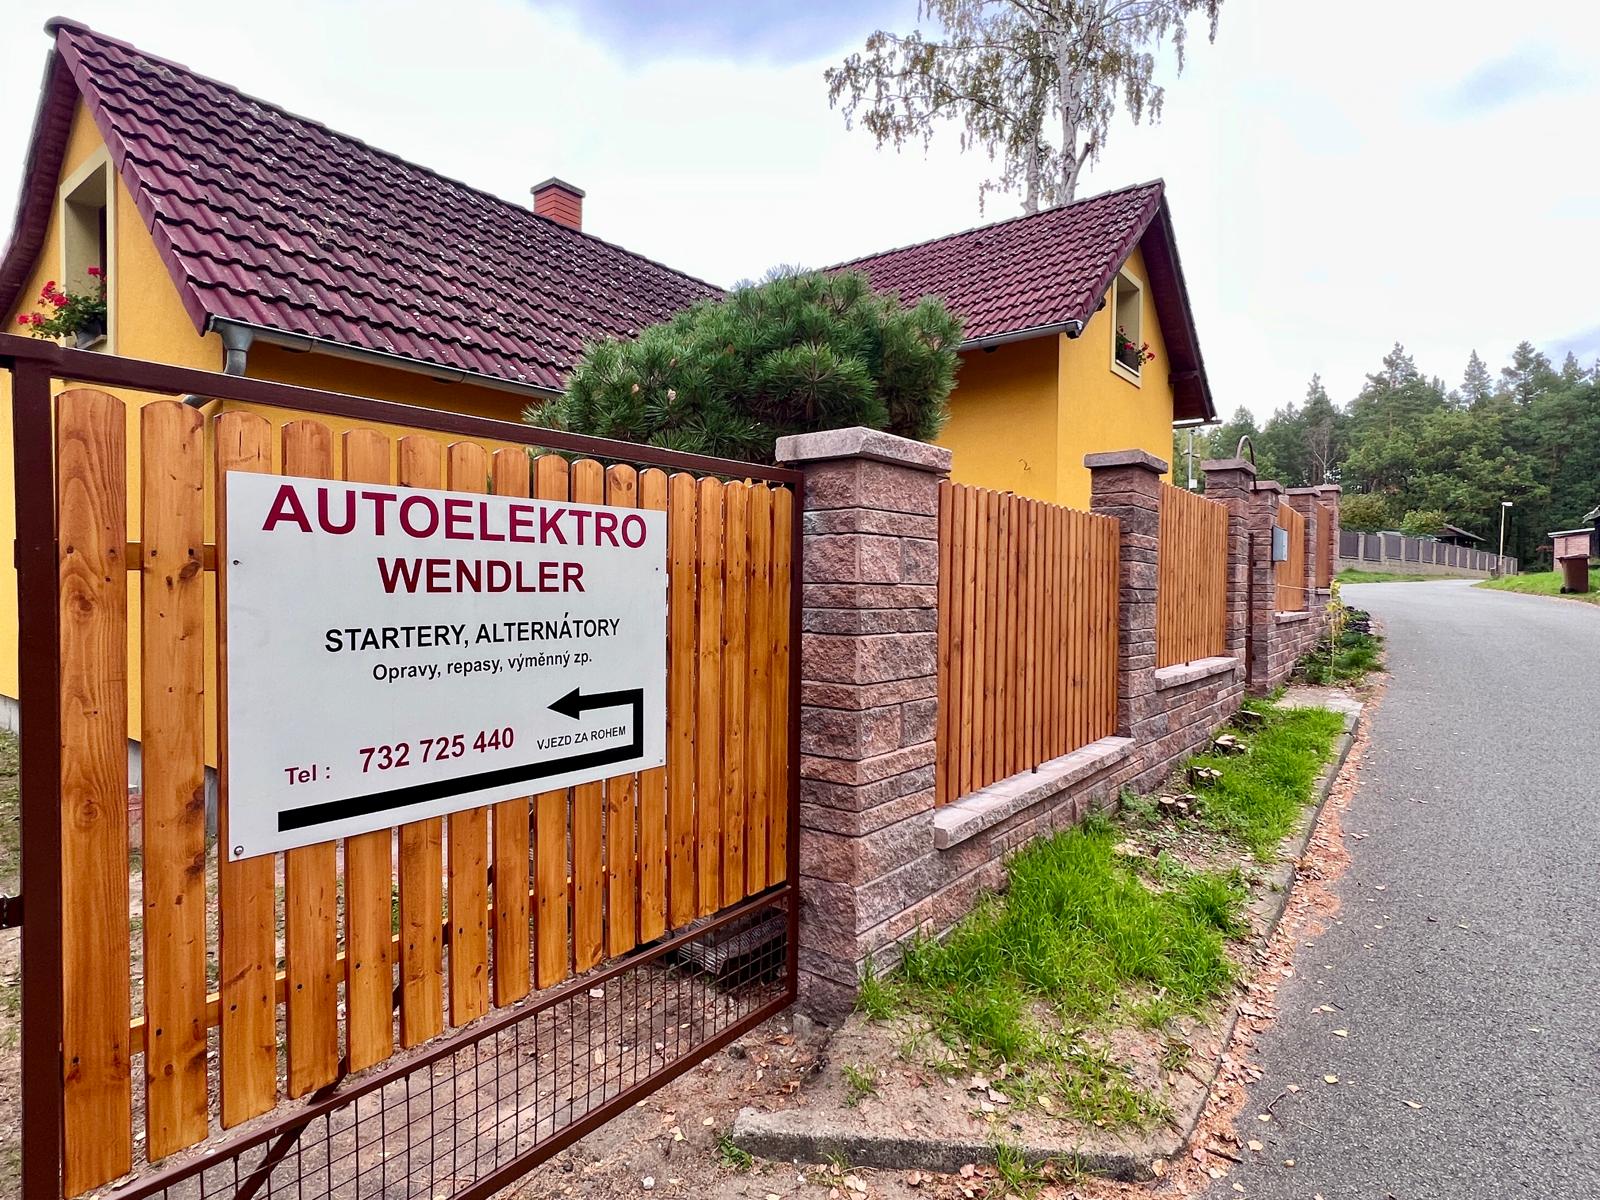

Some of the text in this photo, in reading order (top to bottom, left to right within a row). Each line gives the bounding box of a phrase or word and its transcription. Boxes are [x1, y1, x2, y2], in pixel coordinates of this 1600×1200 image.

[261, 484, 647, 549] AUTOELEKTRO
[376, 557, 586, 594] WENDLER
[324, 611, 621, 653] STARTERY, ALTERNÁTORY
[372, 650, 593, 684] Opravy, repasy, výměnný zp.
[284, 764, 318, 786] Tel
[359, 742, 410, 773] 732
[419, 734, 465, 764] 725
[472, 727, 515, 754] 440
[536, 725, 627, 751] VJEZD ZA ROHEM
